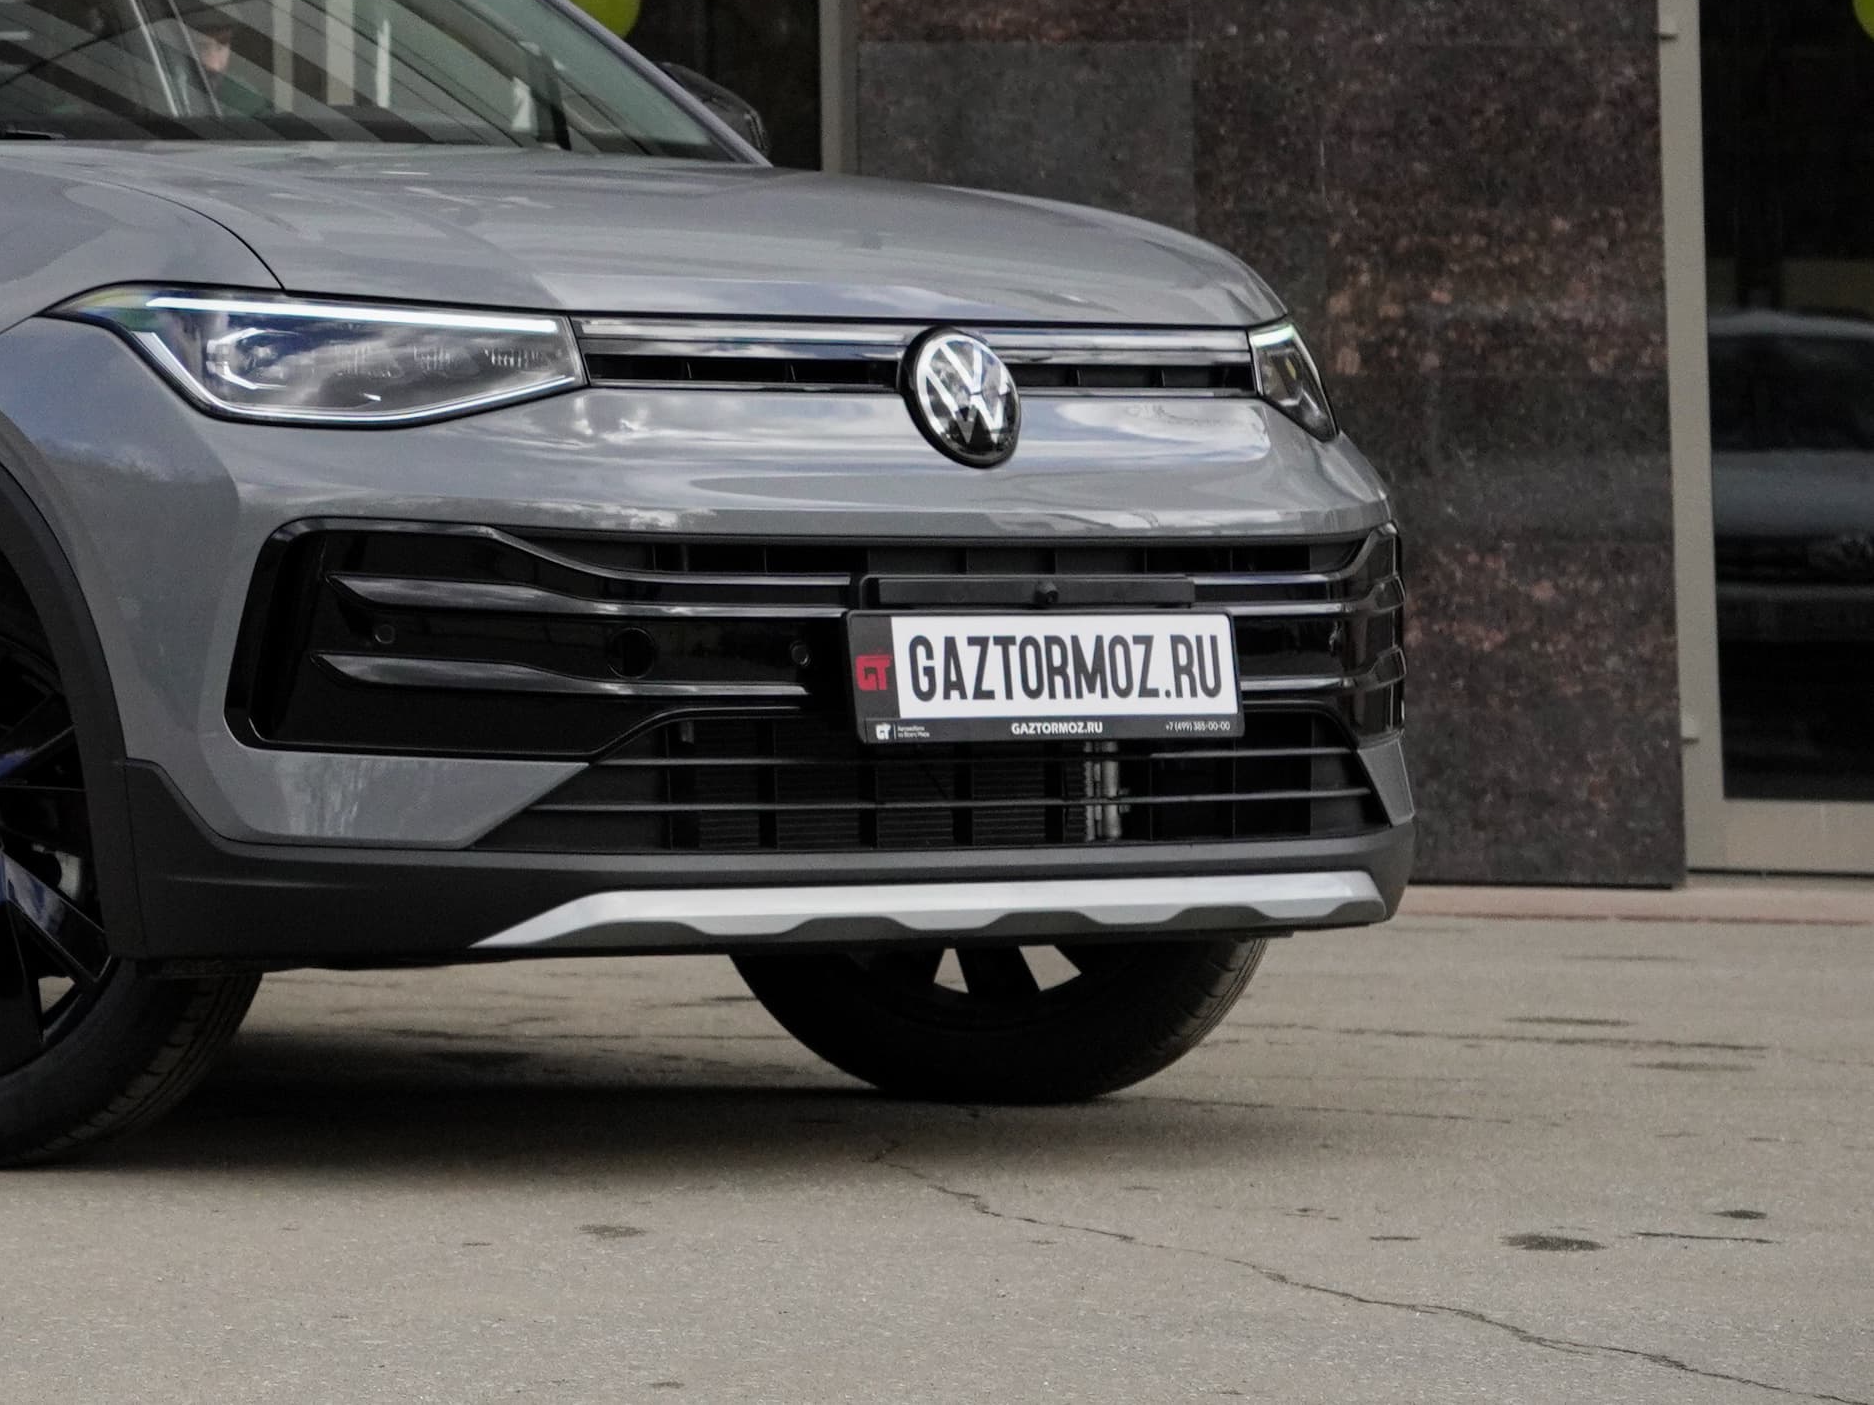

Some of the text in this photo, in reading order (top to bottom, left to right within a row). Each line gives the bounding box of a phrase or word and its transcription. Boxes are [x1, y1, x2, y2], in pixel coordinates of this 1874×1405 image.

[855, 654, 892, 692] GT
[909, 634, 1222, 701] GAZTORMOZ.RU
[1011, 722, 1103, 735] GAZTORMOZ.RU
